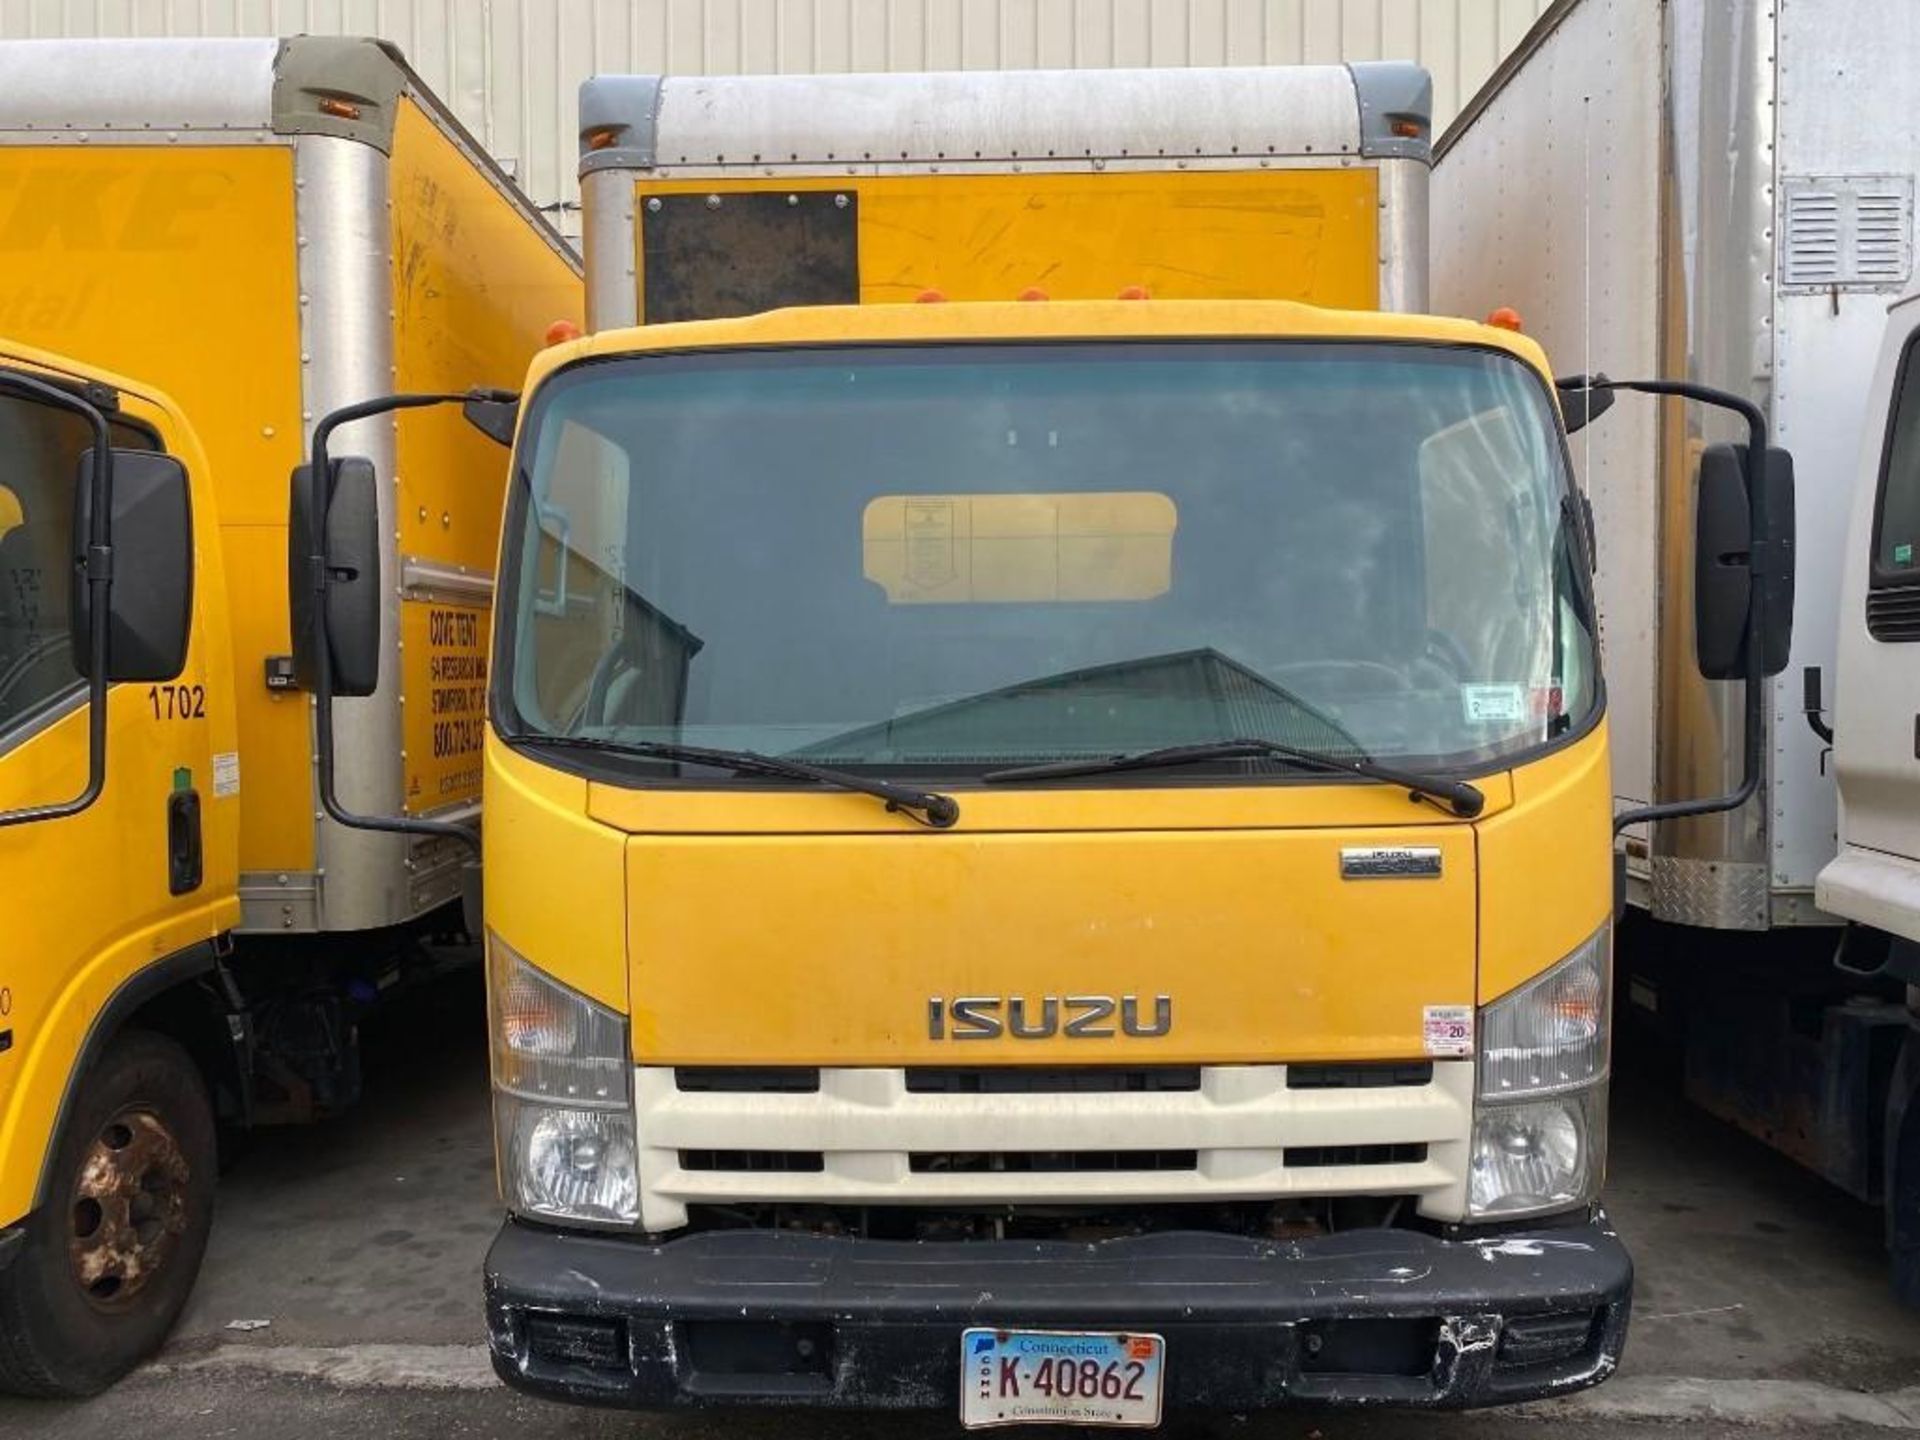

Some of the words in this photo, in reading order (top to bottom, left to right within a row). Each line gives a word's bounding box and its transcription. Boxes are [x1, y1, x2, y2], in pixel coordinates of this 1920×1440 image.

[430, 611, 454, 647] COVE
[456, 613, 477, 648] TENT
[149, 685, 205, 720] 1702
[928, 994, 1172, 1040] ISUZU
[1020, 1340, 1109, 1356] Connecticut
[1000, 1356, 1145, 1400] K-40862
